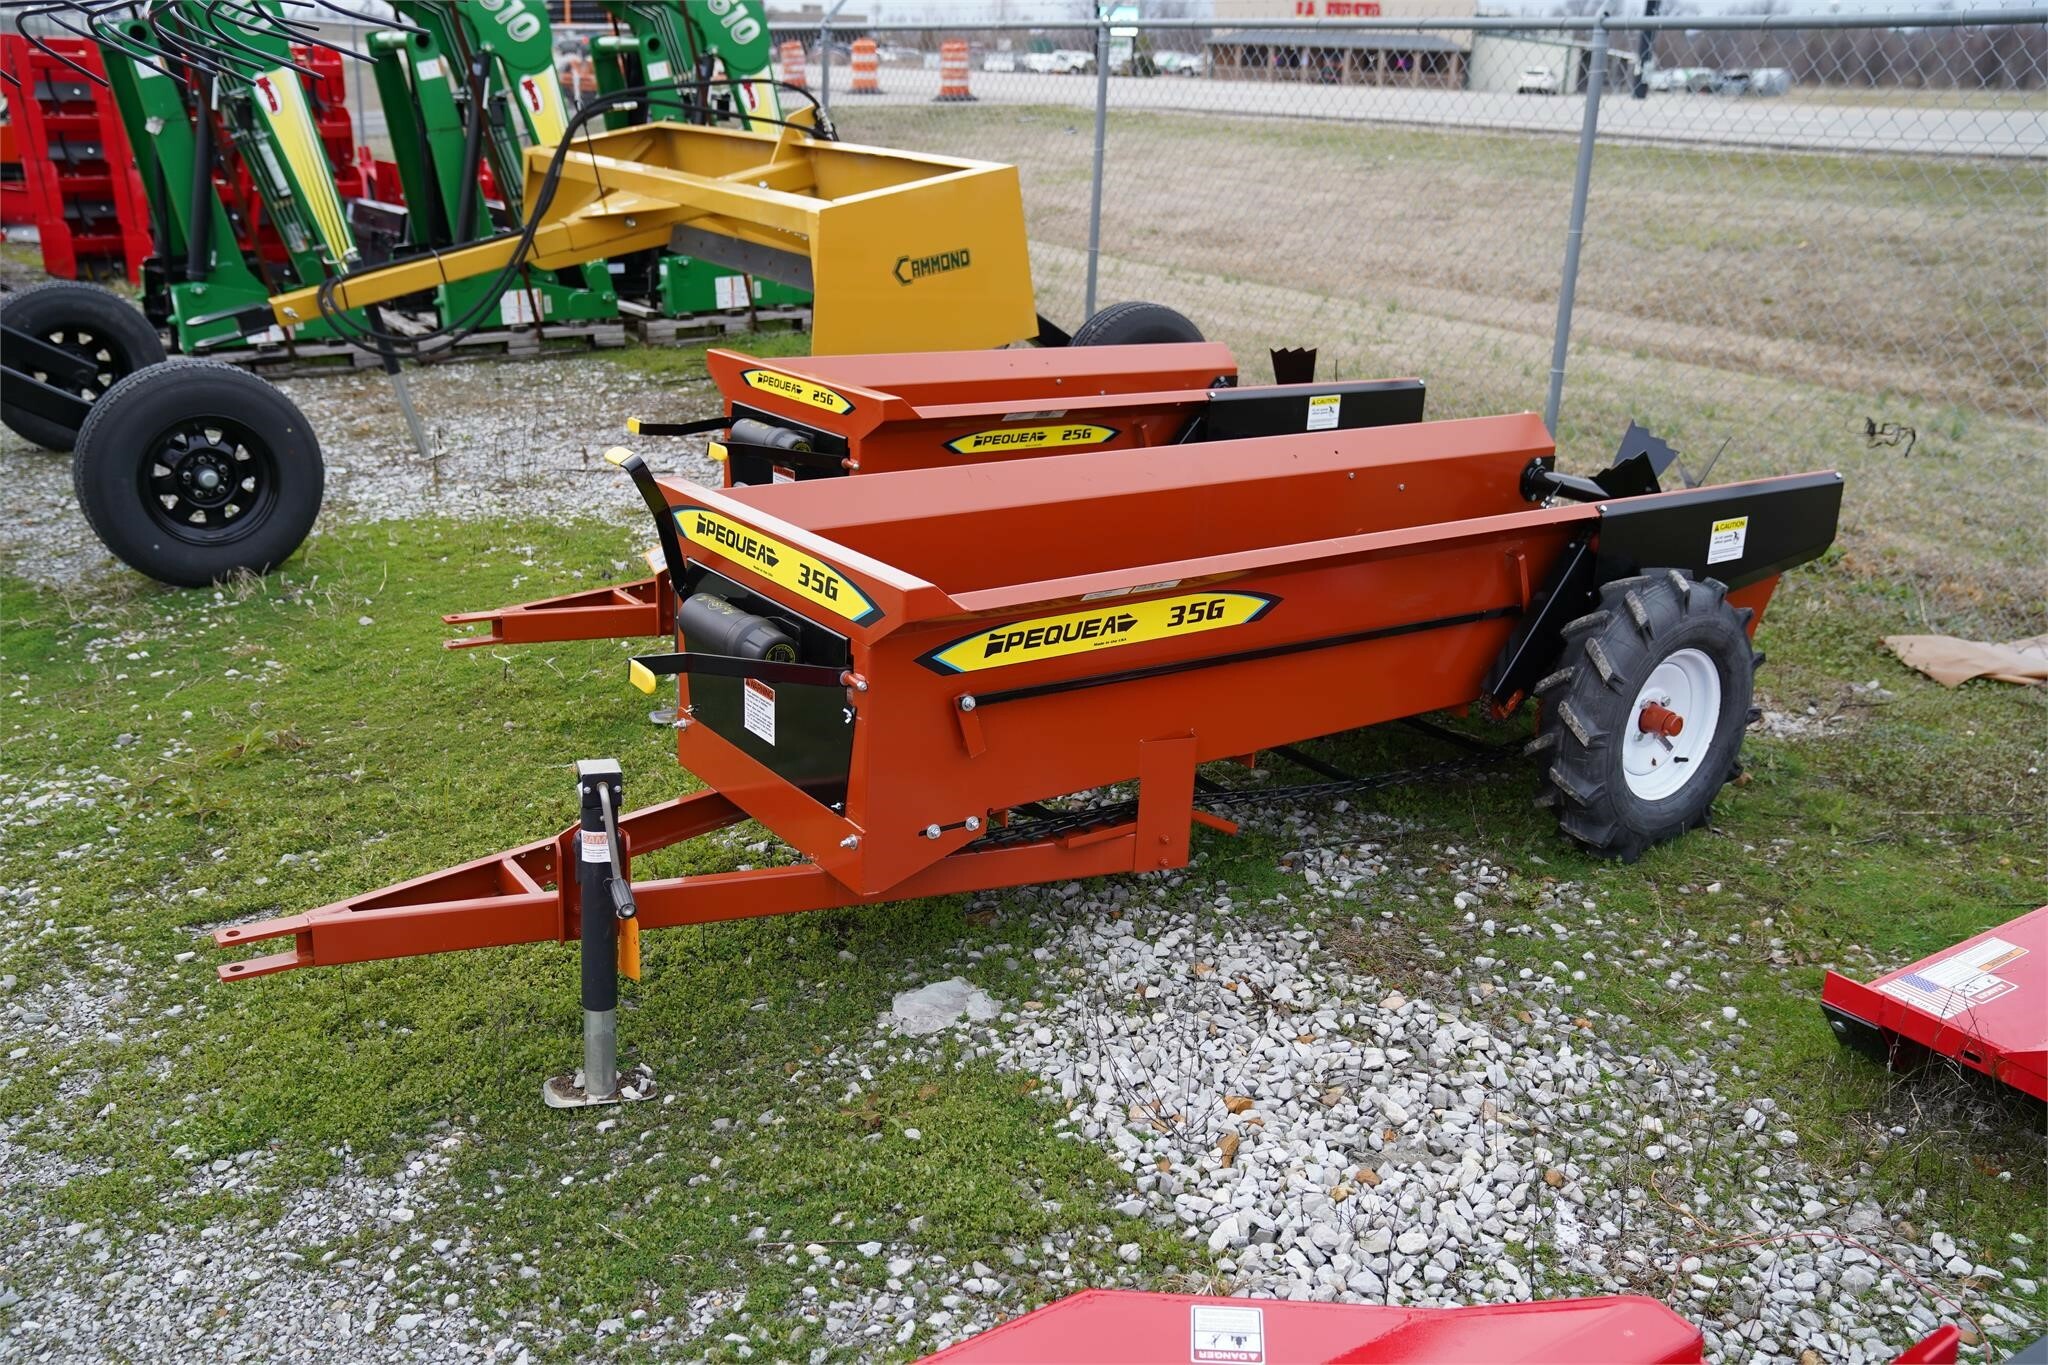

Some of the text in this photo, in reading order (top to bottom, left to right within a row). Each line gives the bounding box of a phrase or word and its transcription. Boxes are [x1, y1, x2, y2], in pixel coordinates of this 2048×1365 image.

[895, 249, 970, 285] CAMMOND
[762, 374, 834, 406] PEQUEA 25G
[982, 428, 1092, 446] PEQUEA 25G
[1719, 520, 1746, 531] CAUTION
[705, 518, 767, 565] PEQUEA
[797, 562, 839, 601] 35G
[1003, 598, 1226, 654] PEQUEA 35G
[1198, 1350, 1248, 1361] DANGER
